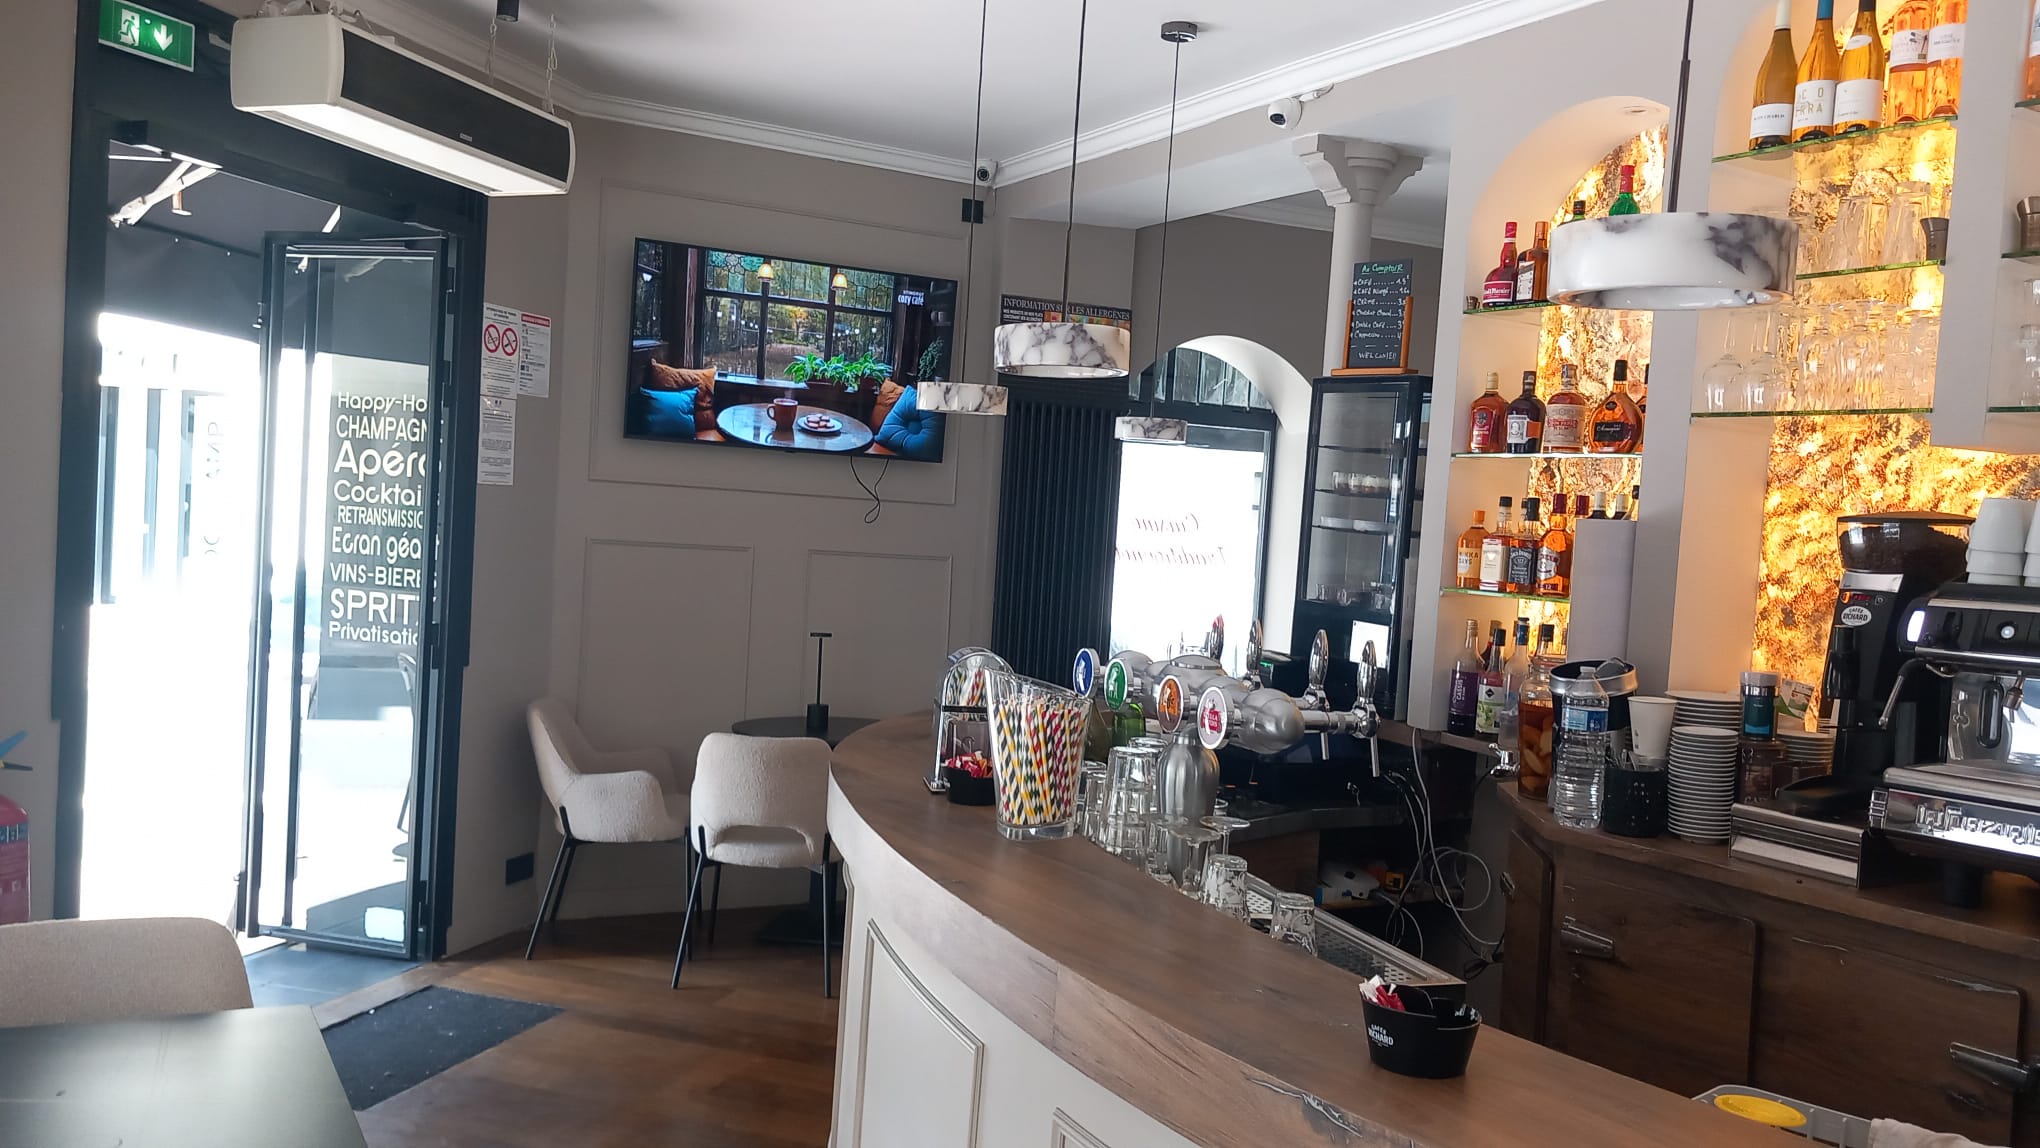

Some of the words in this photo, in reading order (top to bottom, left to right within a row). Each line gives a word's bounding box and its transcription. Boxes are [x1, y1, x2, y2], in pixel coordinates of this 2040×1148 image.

[1003, 297, 1055, 311] INFORMATION
[1071, 305, 1085, 315] LES
[331, 526, 381, 556] Ecran
[330, 588, 420, 626] SPRIT
